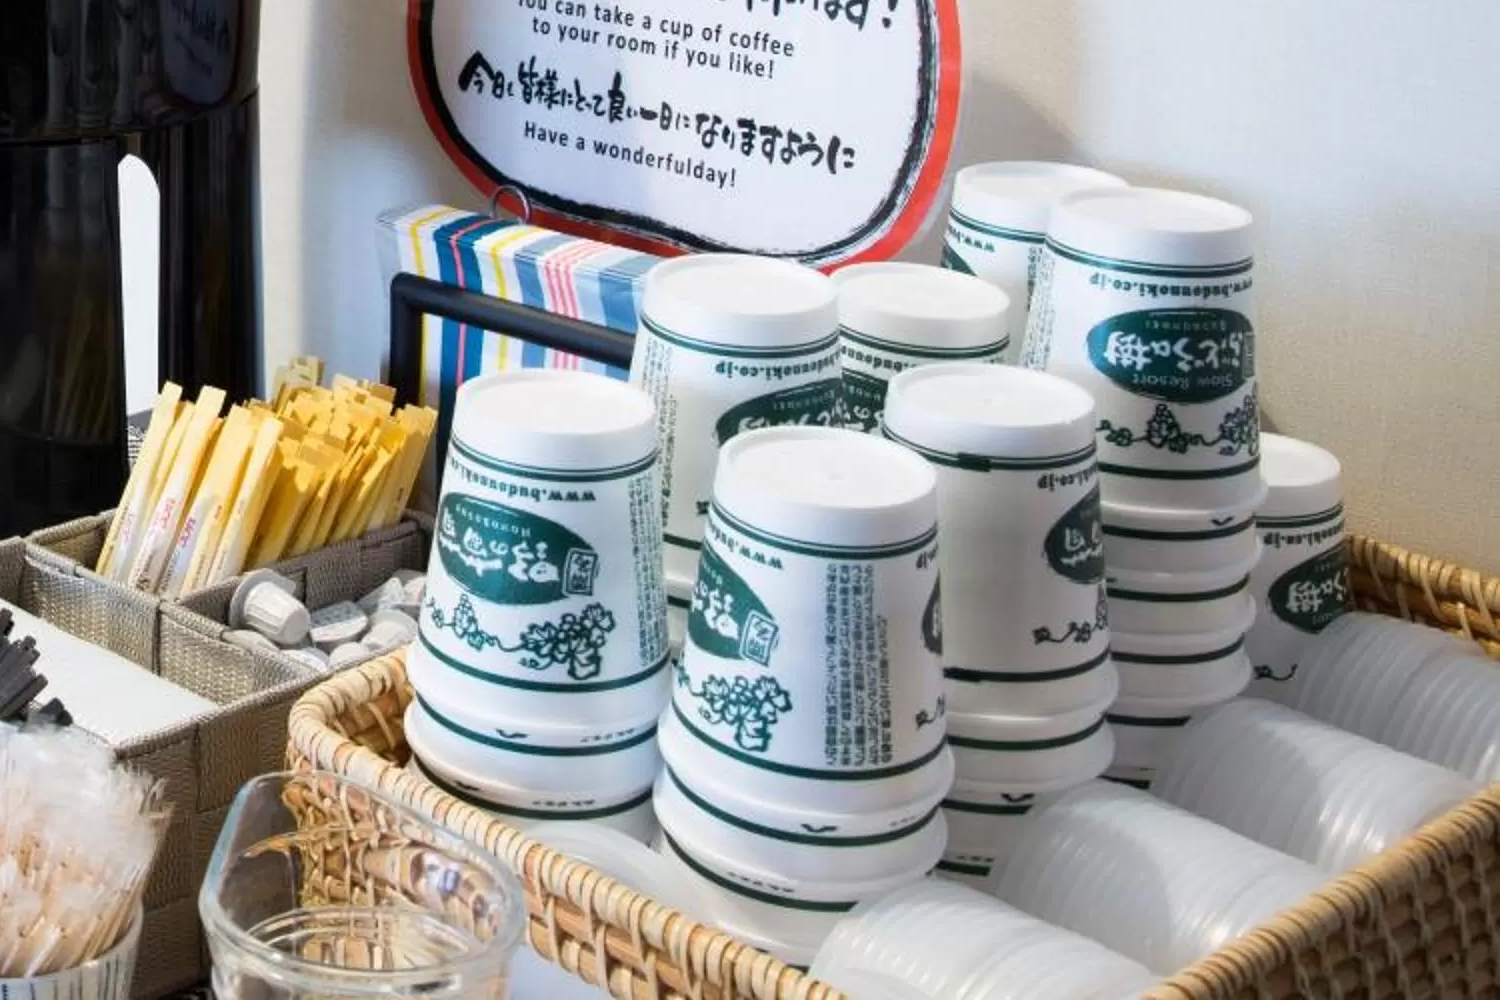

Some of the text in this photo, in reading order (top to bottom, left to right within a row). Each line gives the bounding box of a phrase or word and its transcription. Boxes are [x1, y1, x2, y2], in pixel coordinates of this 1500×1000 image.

[532, 16, 775, 79] to your room if you like!
[555, 1, 587, 18] can
[594, 5, 635, 27] take
[642, 16, 652, 31] a
[660, 18, 694, 41] cup
[701, 23, 723, 44] of
[729, 32, 795, 57] coffee
[524, 121, 738, 189] Have a wonderfulday!
